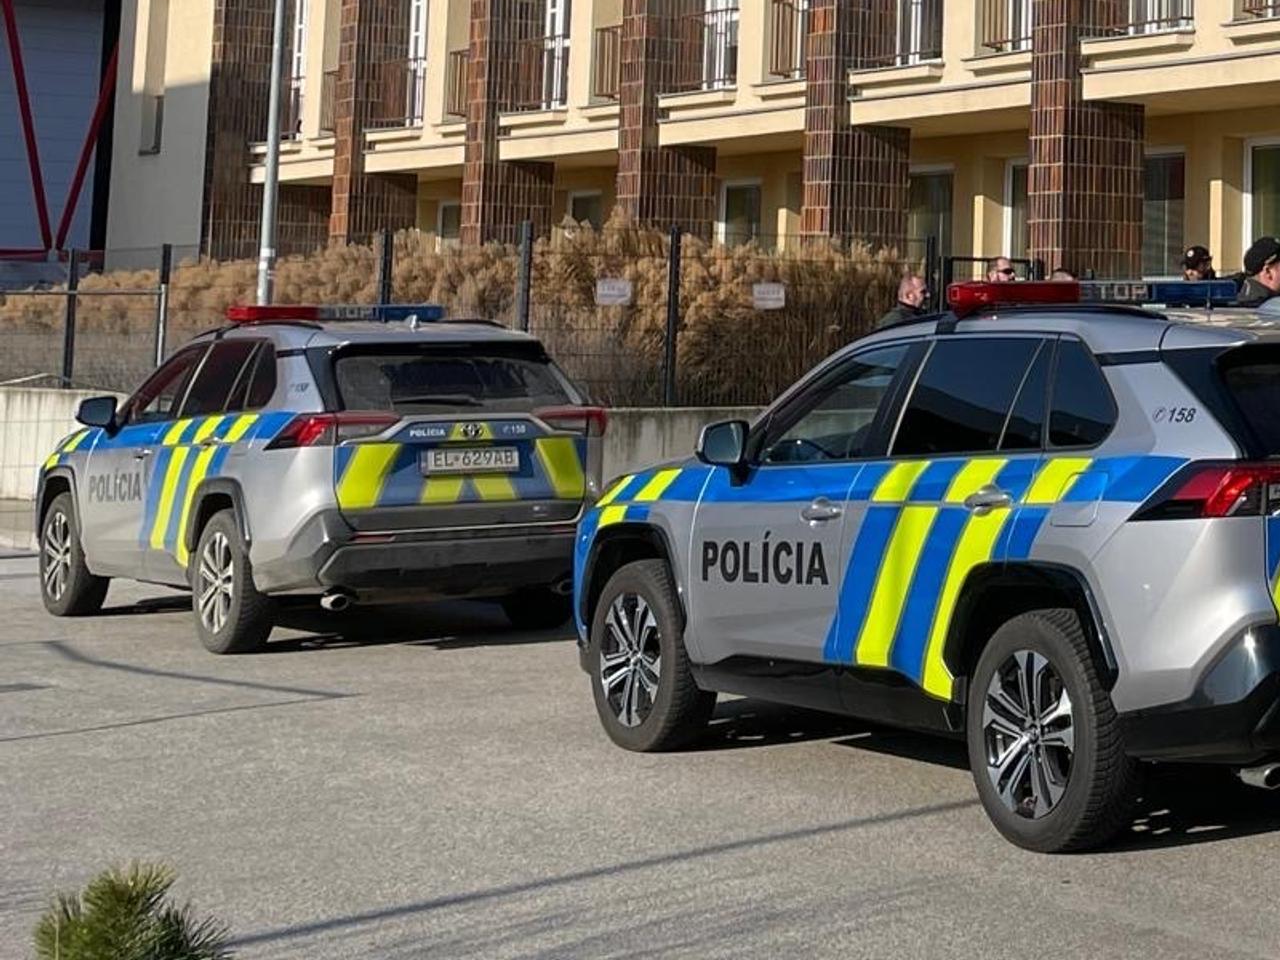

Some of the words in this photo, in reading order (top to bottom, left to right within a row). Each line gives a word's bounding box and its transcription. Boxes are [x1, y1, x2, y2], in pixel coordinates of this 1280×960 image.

[1168, 406, 1197, 423] 158
[433, 451, 454, 467] EL
[88, 468, 142, 503] POLÍCIA
[702, 530, 829, 585] POLÍCIA
